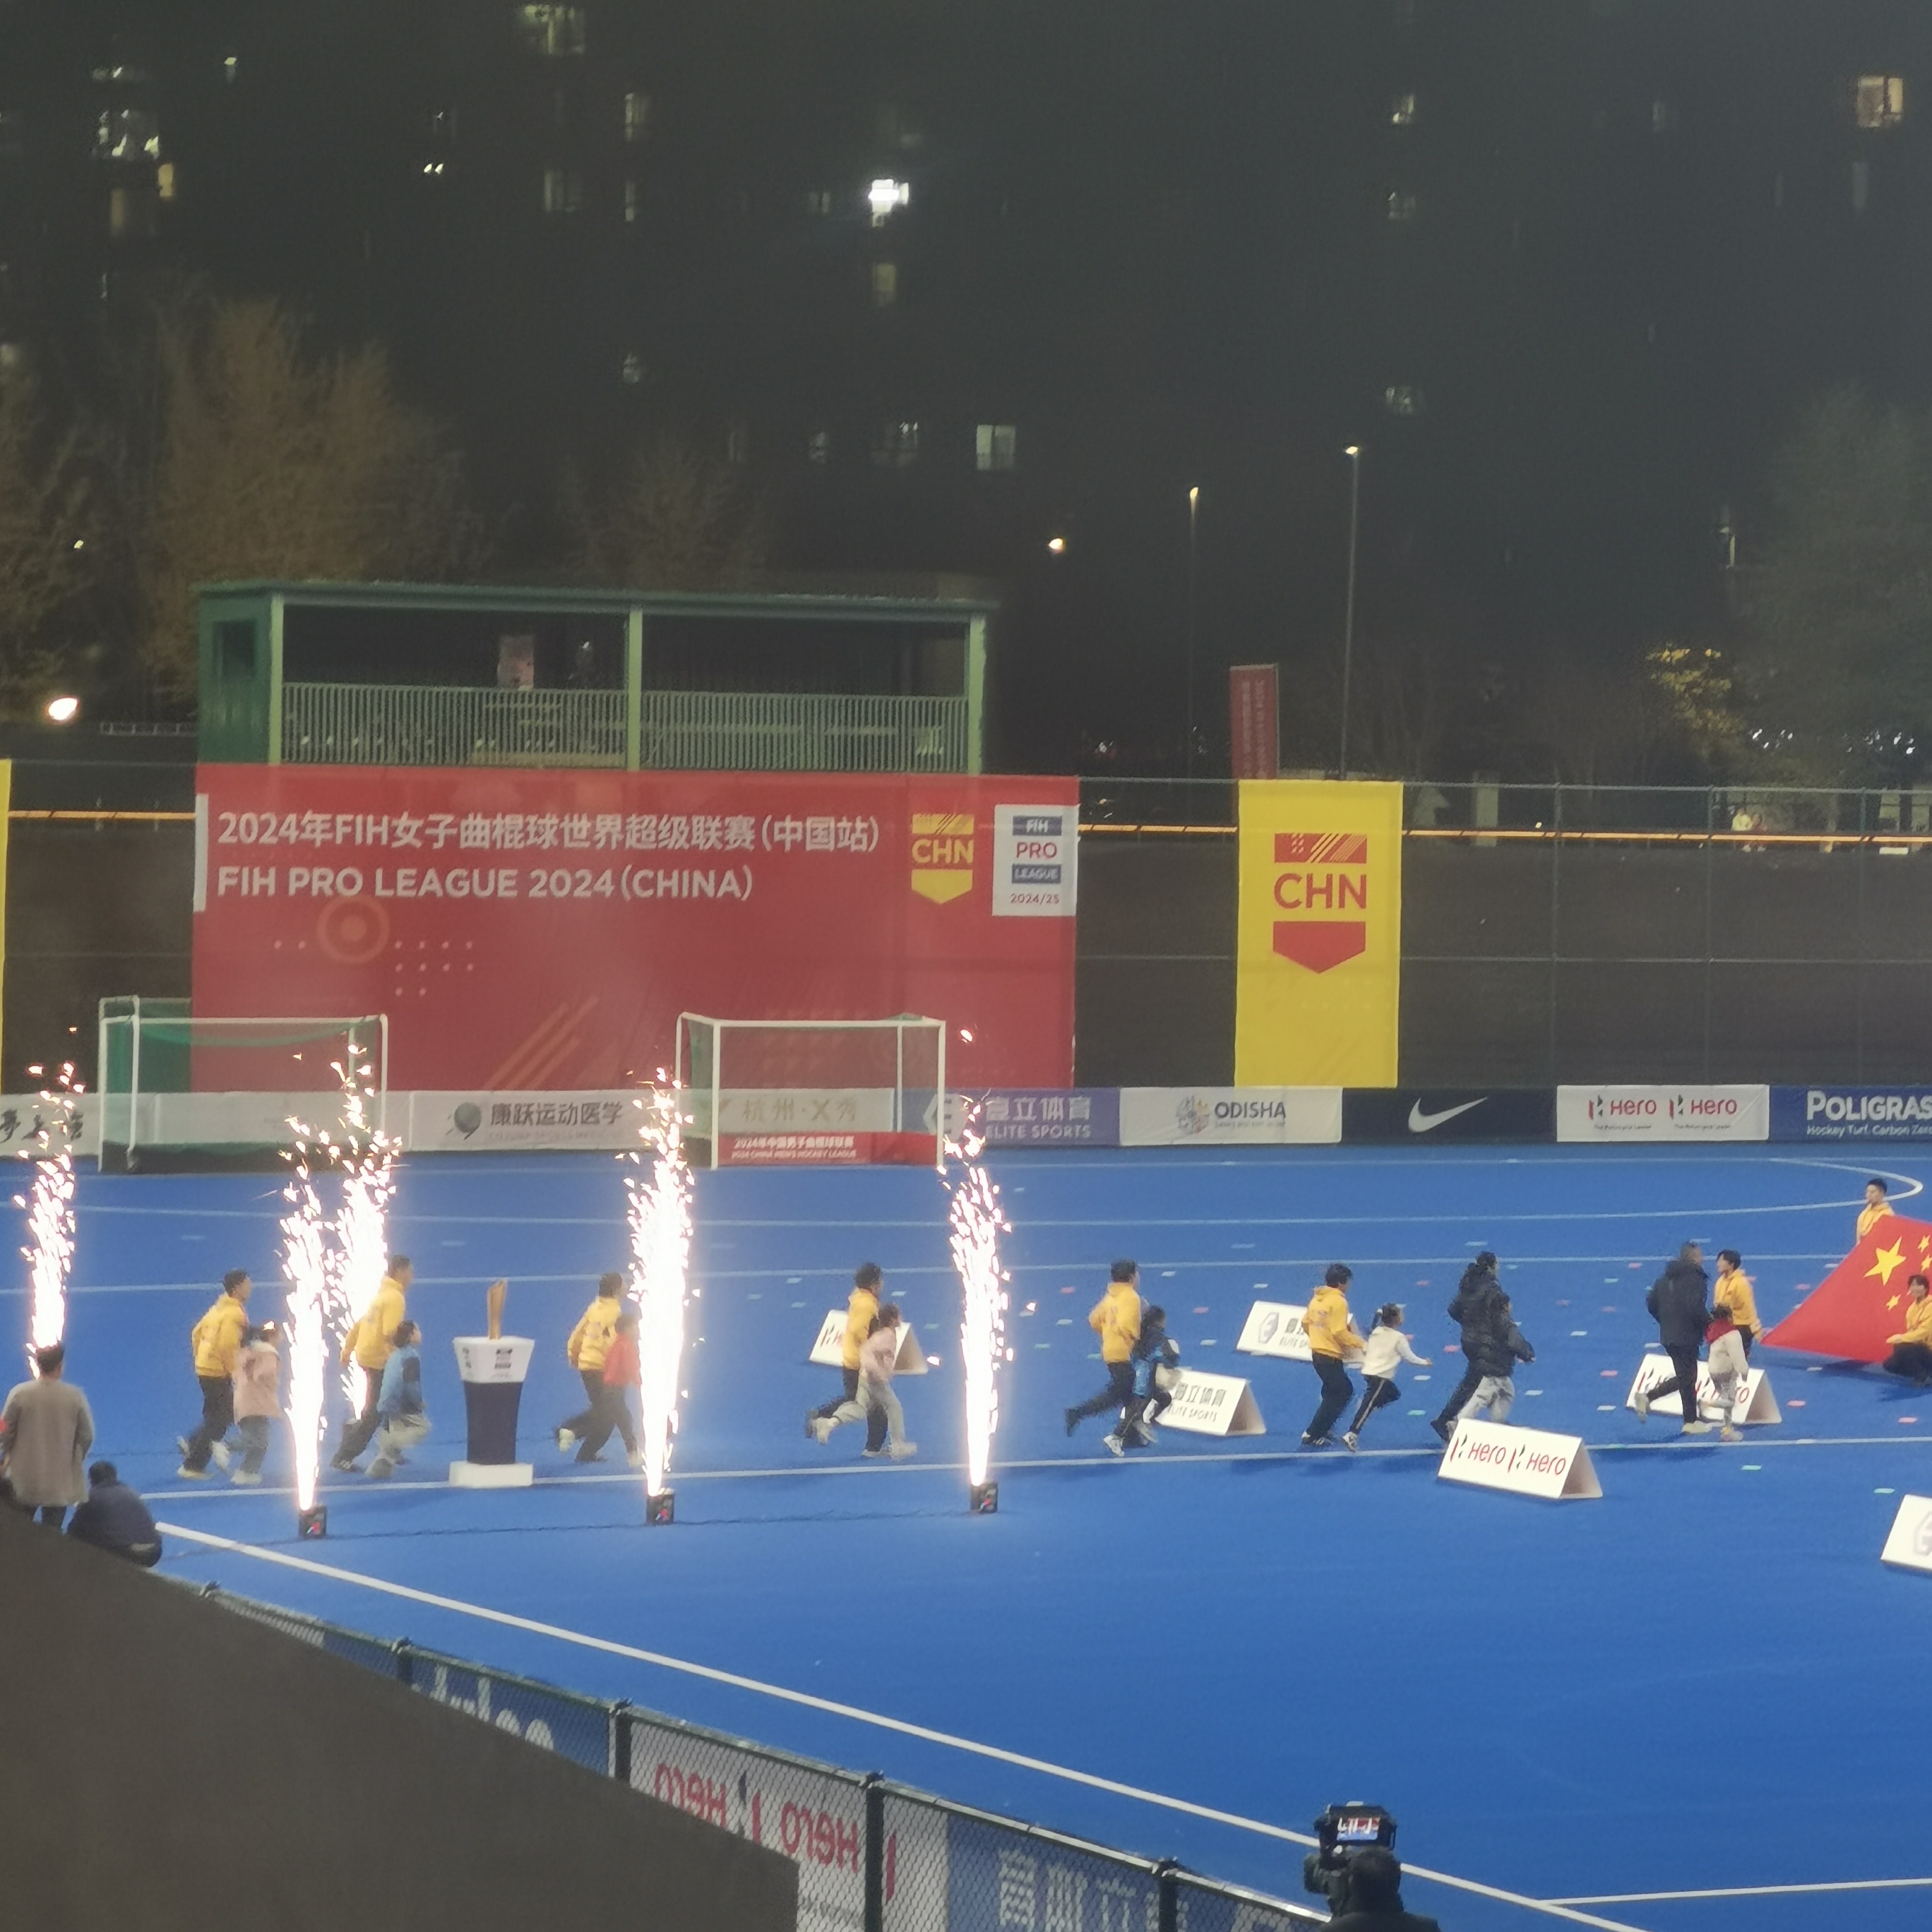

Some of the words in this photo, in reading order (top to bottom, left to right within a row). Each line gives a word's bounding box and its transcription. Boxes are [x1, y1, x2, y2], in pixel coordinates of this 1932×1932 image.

[1026, 818, 1049, 833] FIH
[912, 838, 974, 864] CHN
[1016, 842, 1058, 859] PRO
[217, 866, 275, 897] FIH
[288, 866, 364, 898] PRO
[375, 867, 518, 898] LEAGUE
[1014, 867, 1059, 881] LEAGUE
[1010, 893, 1060, 905] 2024/25
[1274, 873, 1367, 909] CHN
[1214, 1101, 1287, 1119] ODISHA
[1610, 1099, 1657, 1116] Hero
[1690, 1099, 1739, 1116] Hero
[986, 1123, 1025, 1139] ELITE
[1030, 1123, 1091, 1139] SPORTS
[1467, 1441, 1506, 1465] Hero
[1526, 1452, 1566, 1476] Hero
